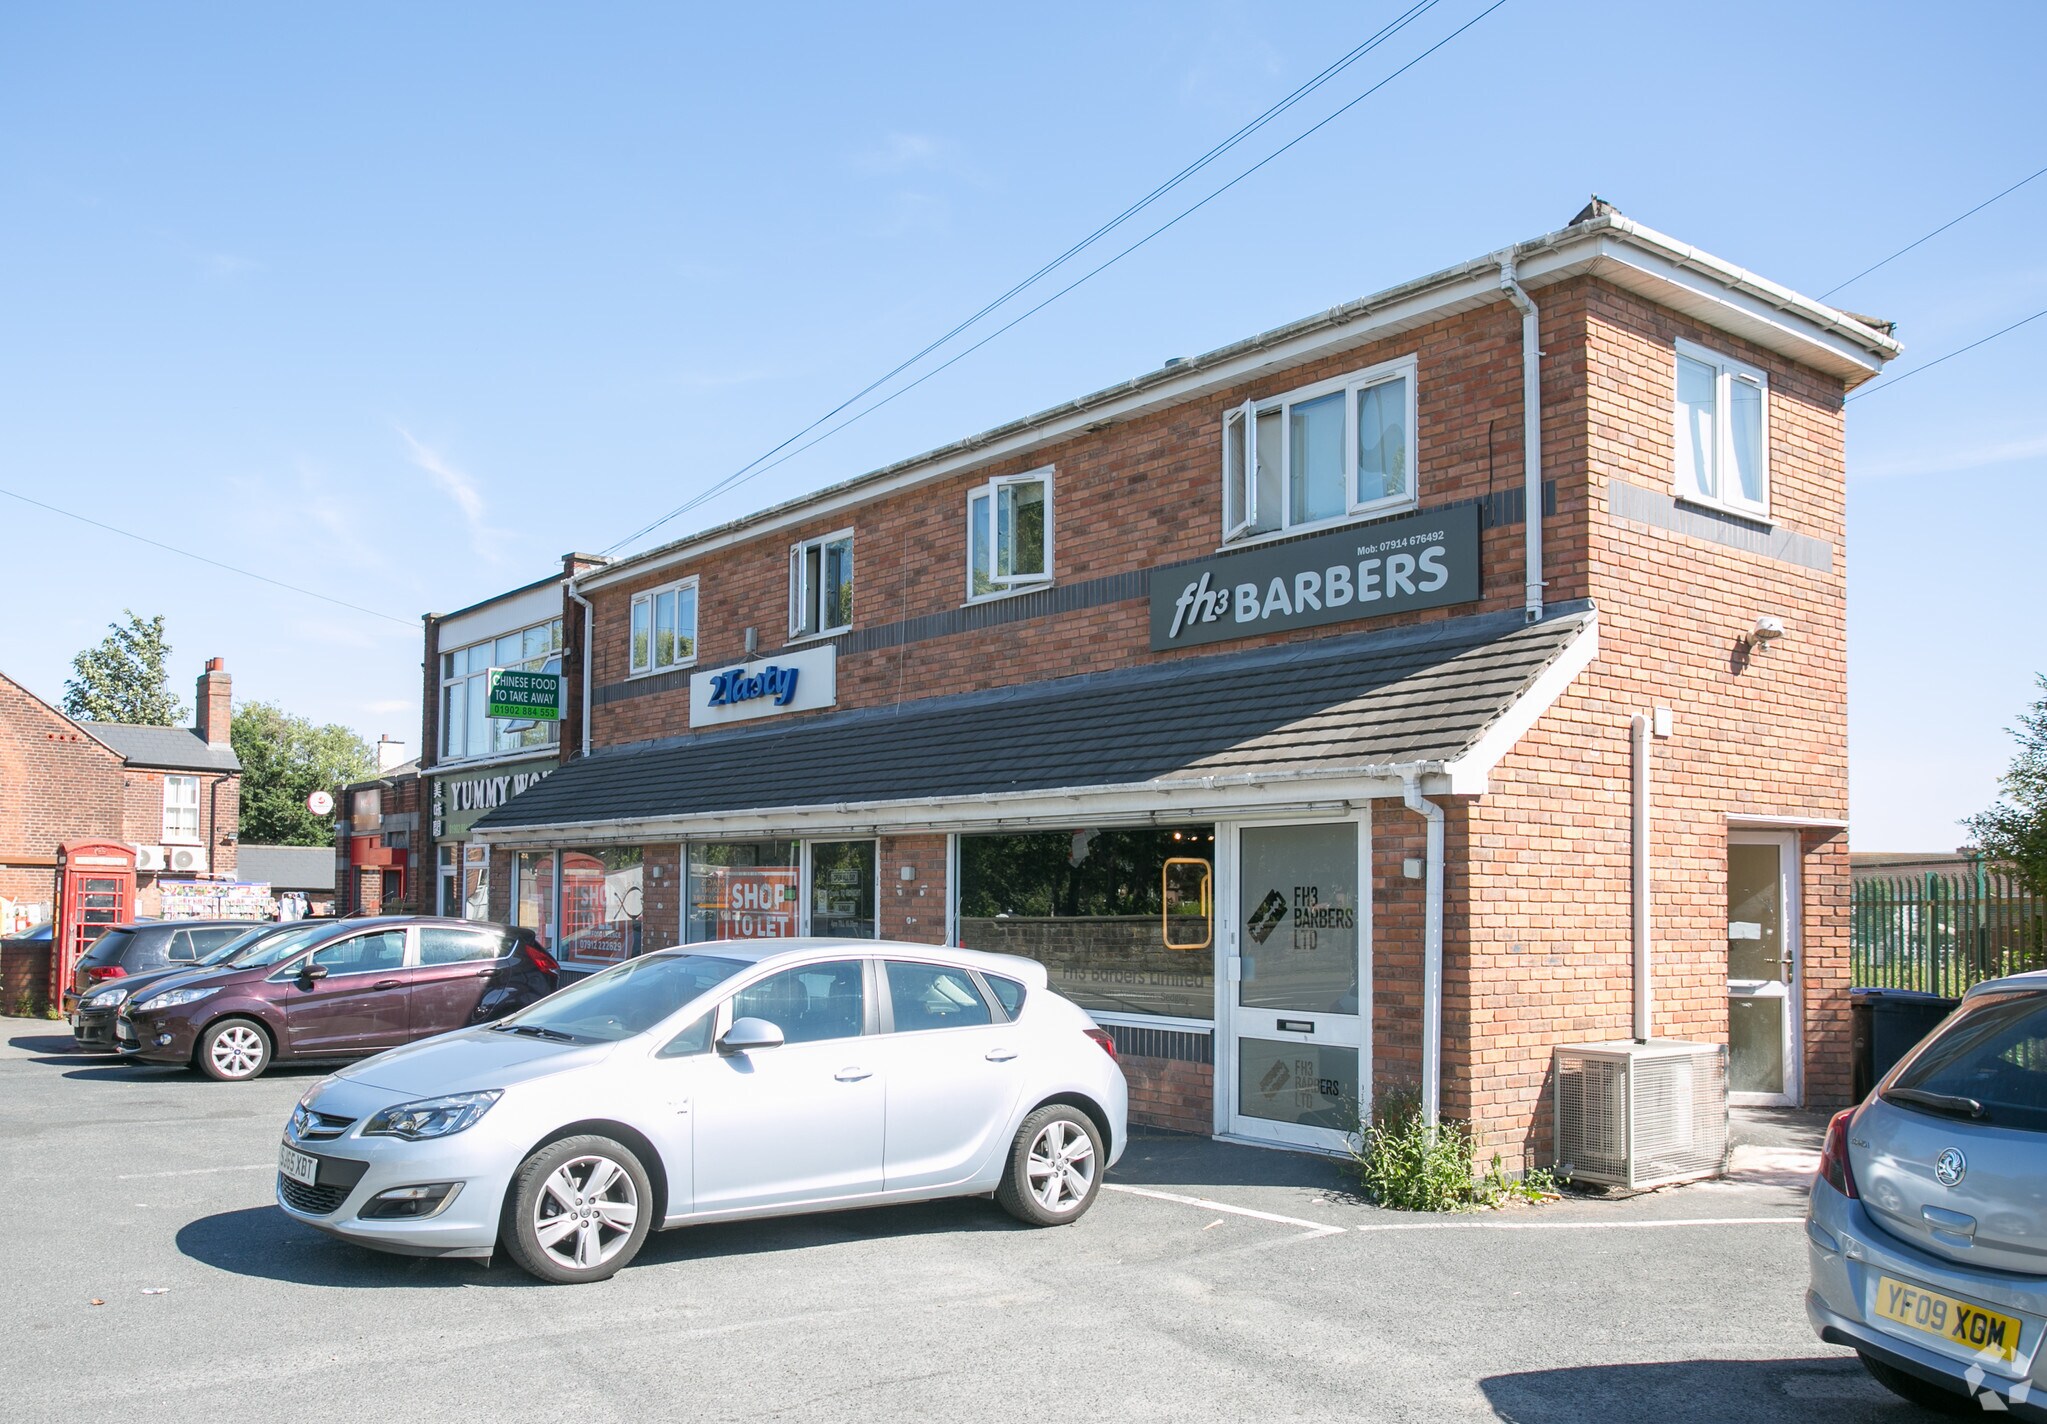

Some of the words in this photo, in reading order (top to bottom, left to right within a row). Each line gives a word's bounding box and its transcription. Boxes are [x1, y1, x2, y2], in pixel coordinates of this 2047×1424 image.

[1357, 545, 1378, 556] Mob:
[1380, 538, 1407, 552] 07914
[1409, 530, 1444, 545] 676492
[1235, 546, 1448, 624] BARBERS
[493, 674, 528, 689] CHINESE
[531, 678, 557, 690] FOOD
[496, 689, 507, 701] TO
[509, 690, 528, 703] TAKE
[530, 692, 554, 704] AWAY
[494, 705, 520, 715] 01902
[522, 707, 537, 716] 884
[540, 708, 555, 717] 553
[451, 775, 510, 811] YUMMY
[732, 883, 784, 909] SHOP
[1294, 887, 1318, 907] FH3
[732, 914, 753, 935] TO
[757, 915, 788, 937] LET
[1294, 908, 1353, 929] BARBERS
[1294, 929, 1317, 950] LTD
[1295, 1060, 1313, 1076] FH3
[1889, 1284, 1948, 1331] YF09
